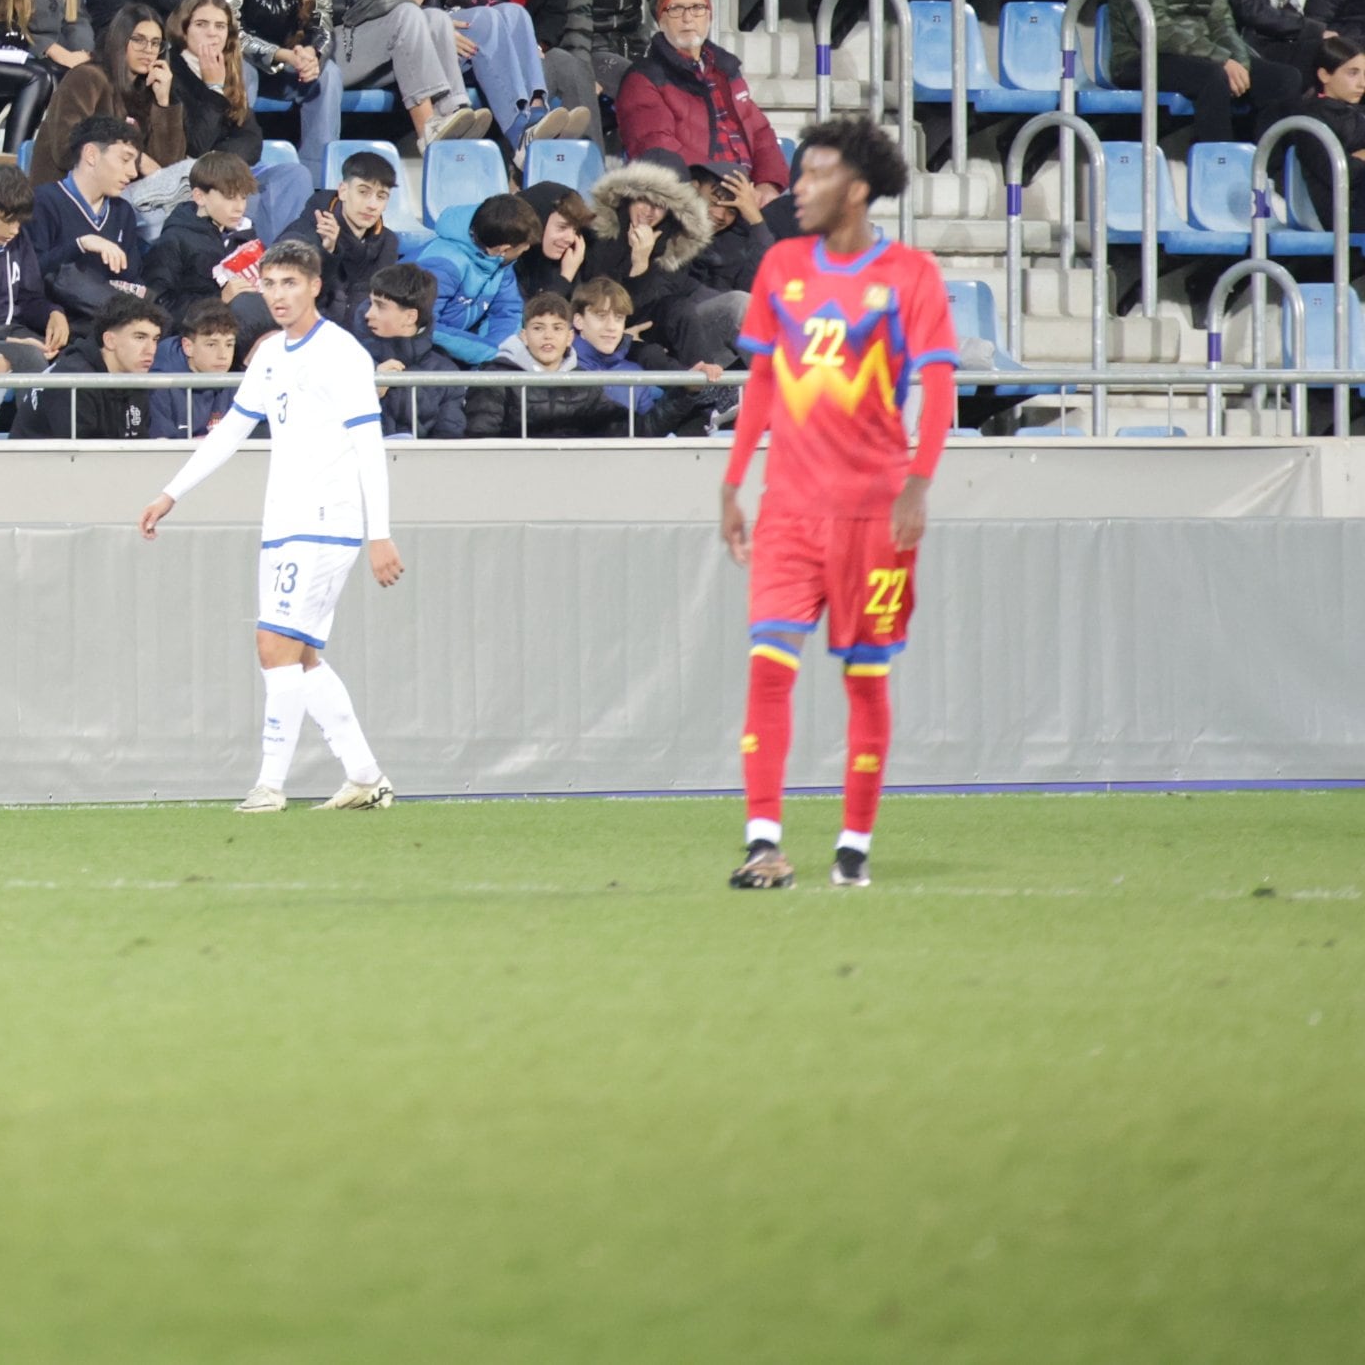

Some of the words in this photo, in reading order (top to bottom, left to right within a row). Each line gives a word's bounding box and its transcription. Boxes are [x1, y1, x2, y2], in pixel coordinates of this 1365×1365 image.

[801, 317, 846, 368] 22
[274, 562, 299, 594] 13
[864, 568, 908, 615] 22
